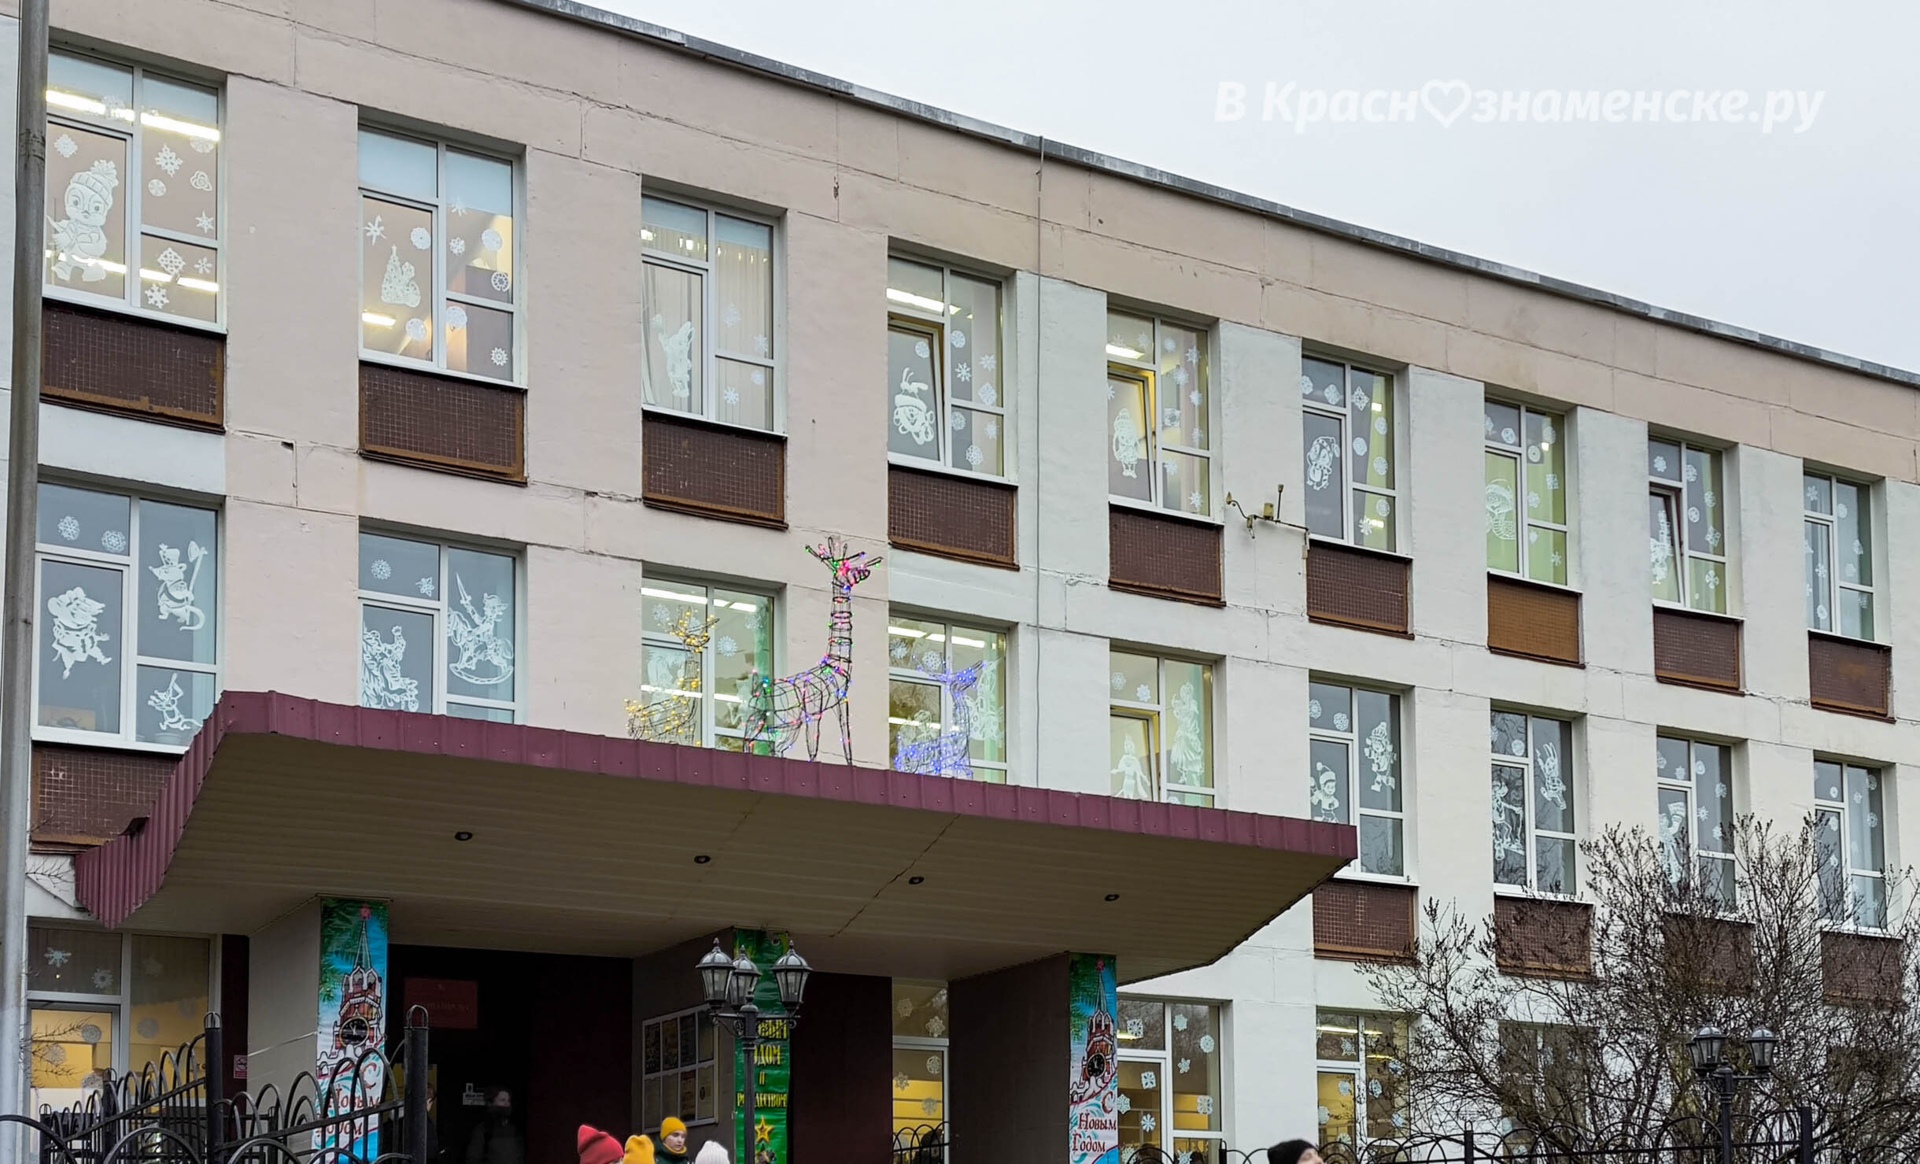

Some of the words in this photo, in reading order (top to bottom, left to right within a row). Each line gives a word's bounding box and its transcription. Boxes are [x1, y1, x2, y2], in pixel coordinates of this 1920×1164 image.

[1102, 1091, 1113, 1113] С
[1078, 1111, 1117, 1131] Новым
[1072, 1130, 1106, 1154] Годом
